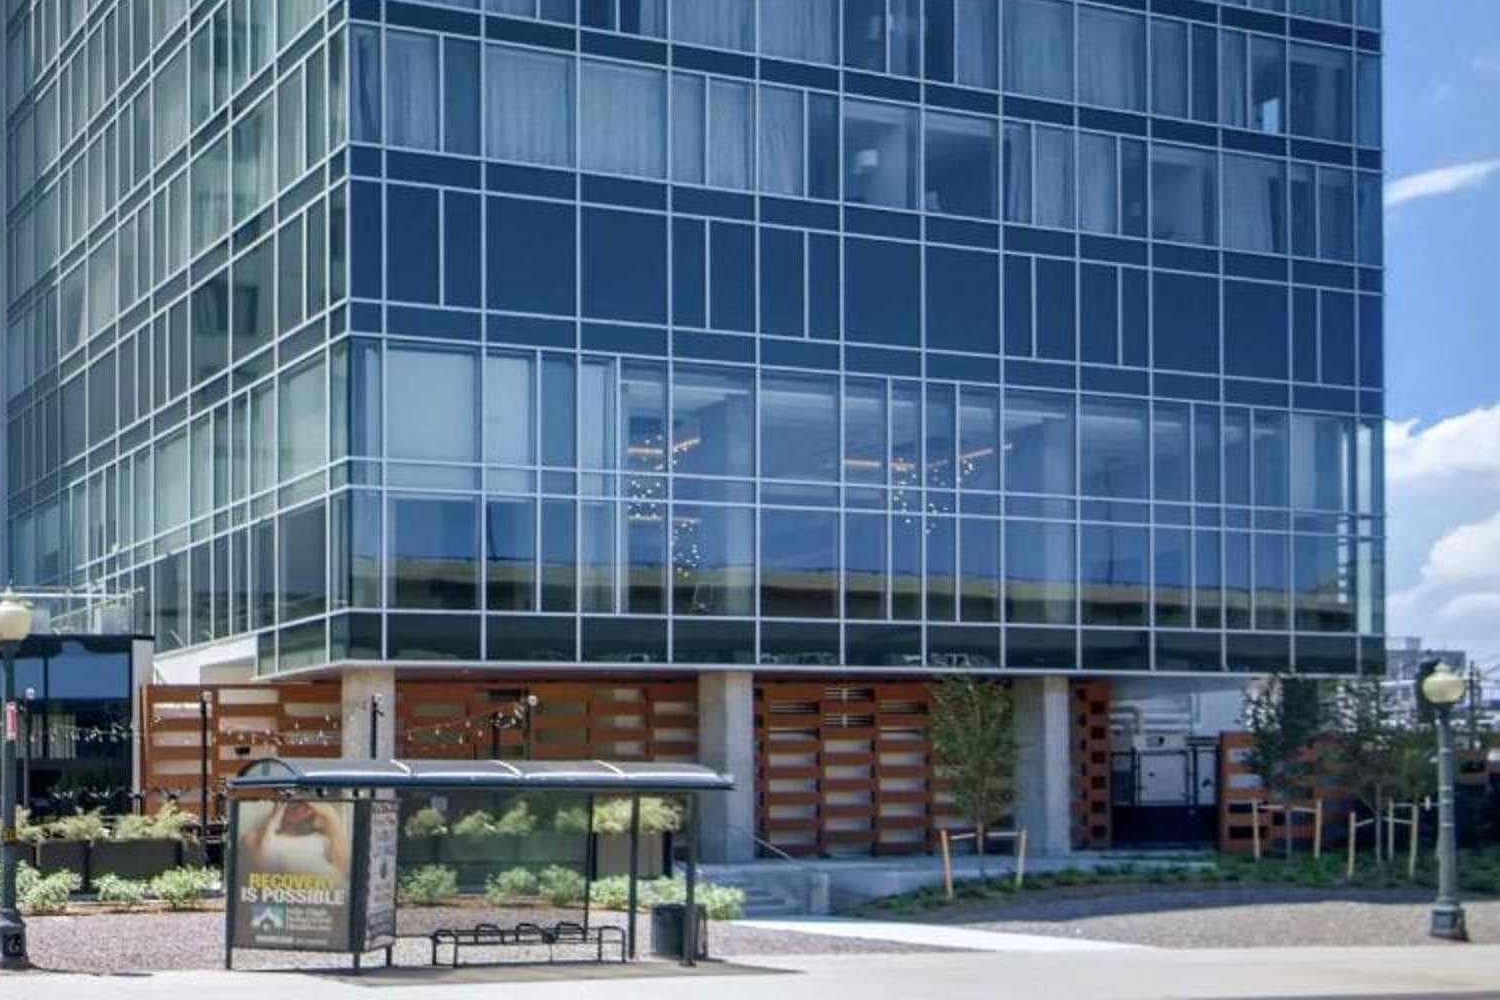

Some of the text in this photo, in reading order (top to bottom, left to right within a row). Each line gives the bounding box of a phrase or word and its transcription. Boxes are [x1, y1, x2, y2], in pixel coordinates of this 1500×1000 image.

[249, 872, 334, 889] RECOVERY
[240, 887, 345, 905] IS POSSIBLE
